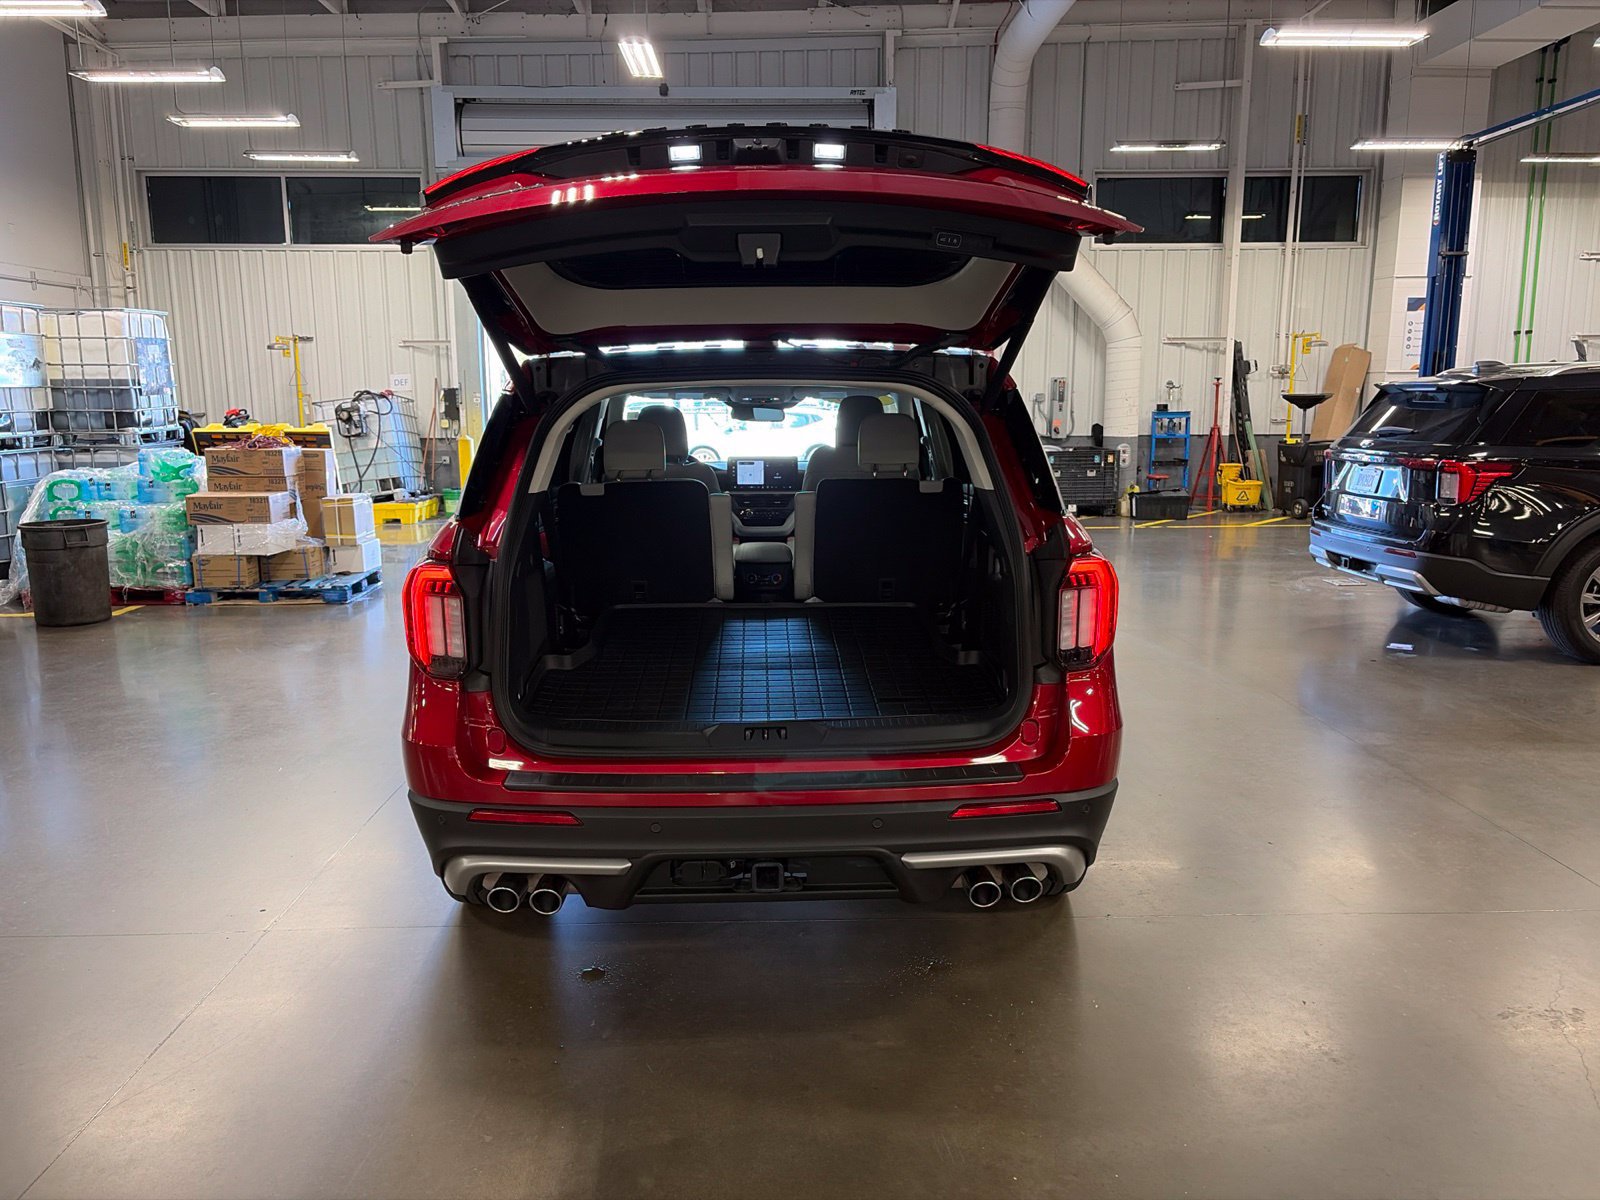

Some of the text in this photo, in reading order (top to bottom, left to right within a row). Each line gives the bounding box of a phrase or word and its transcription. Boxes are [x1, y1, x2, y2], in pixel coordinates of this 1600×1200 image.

[1433, 178, 1443, 221] ROTARY
[393, 378, 409, 386] DEF
[211, 453, 240, 465] Mayfair
[213, 481, 243, 492] Mayfair
[193, 501, 223, 511] Mayfair
